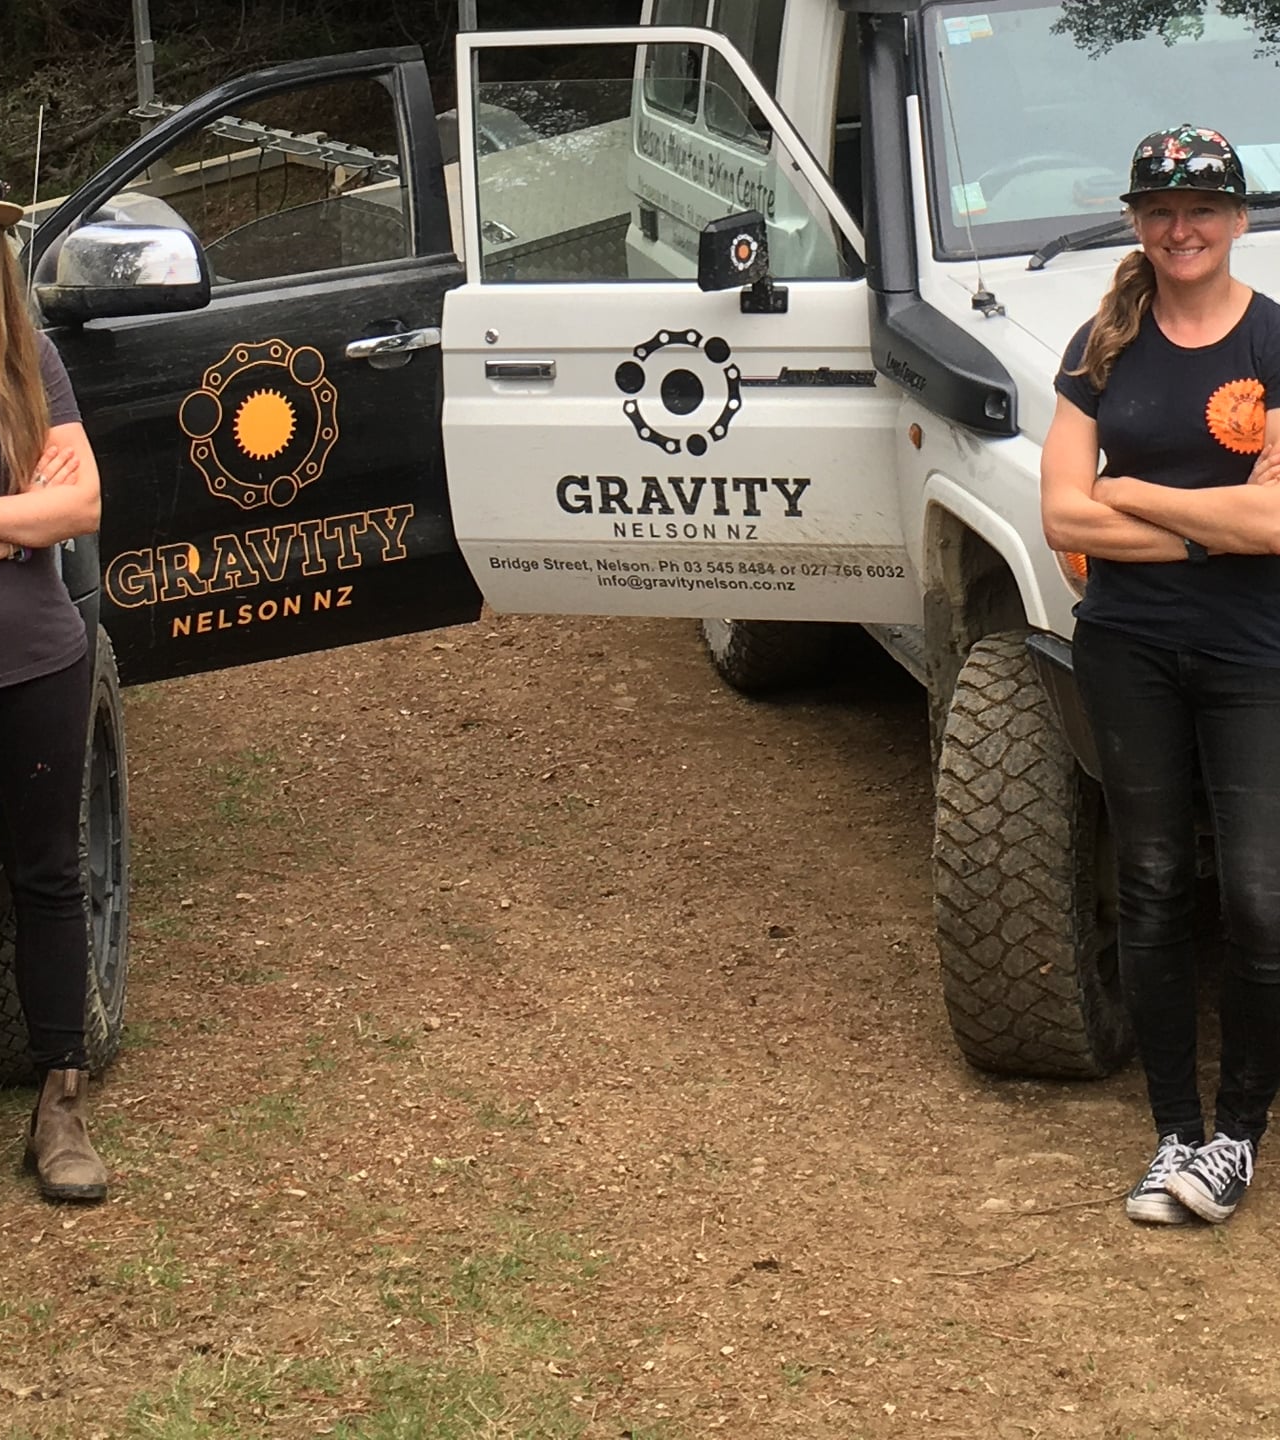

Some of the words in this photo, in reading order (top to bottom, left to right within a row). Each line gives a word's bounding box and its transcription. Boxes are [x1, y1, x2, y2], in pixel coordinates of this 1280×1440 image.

[736, 166, 776, 219] Centre
[556, 474, 812, 518] GRAVITY
[613, 522, 717, 539] NELSON
[727, 524, 759, 540] NZ
[105, 504, 414, 608] GRAVITY
[489, 556, 540, 572] Bridge
[543, 557, 593, 572] Street,
[596, 559, 655, 572] Nelson.
[658, 560, 680, 573] Ph
[683, 561, 702, 574] 03
[707, 561, 735, 574] 545
[738, 562, 775, 575] 8484
[780, 564, 796, 576] or
[801, 563, 827, 576] 027
[835, 564, 862, 577] 766
[866, 565, 905, 578] 6032
[597, 574, 796, 591] info@gravitynelson.co.nz
[172, 594, 302, 638] NELSON
[313, 585, 354, 611] NZ
